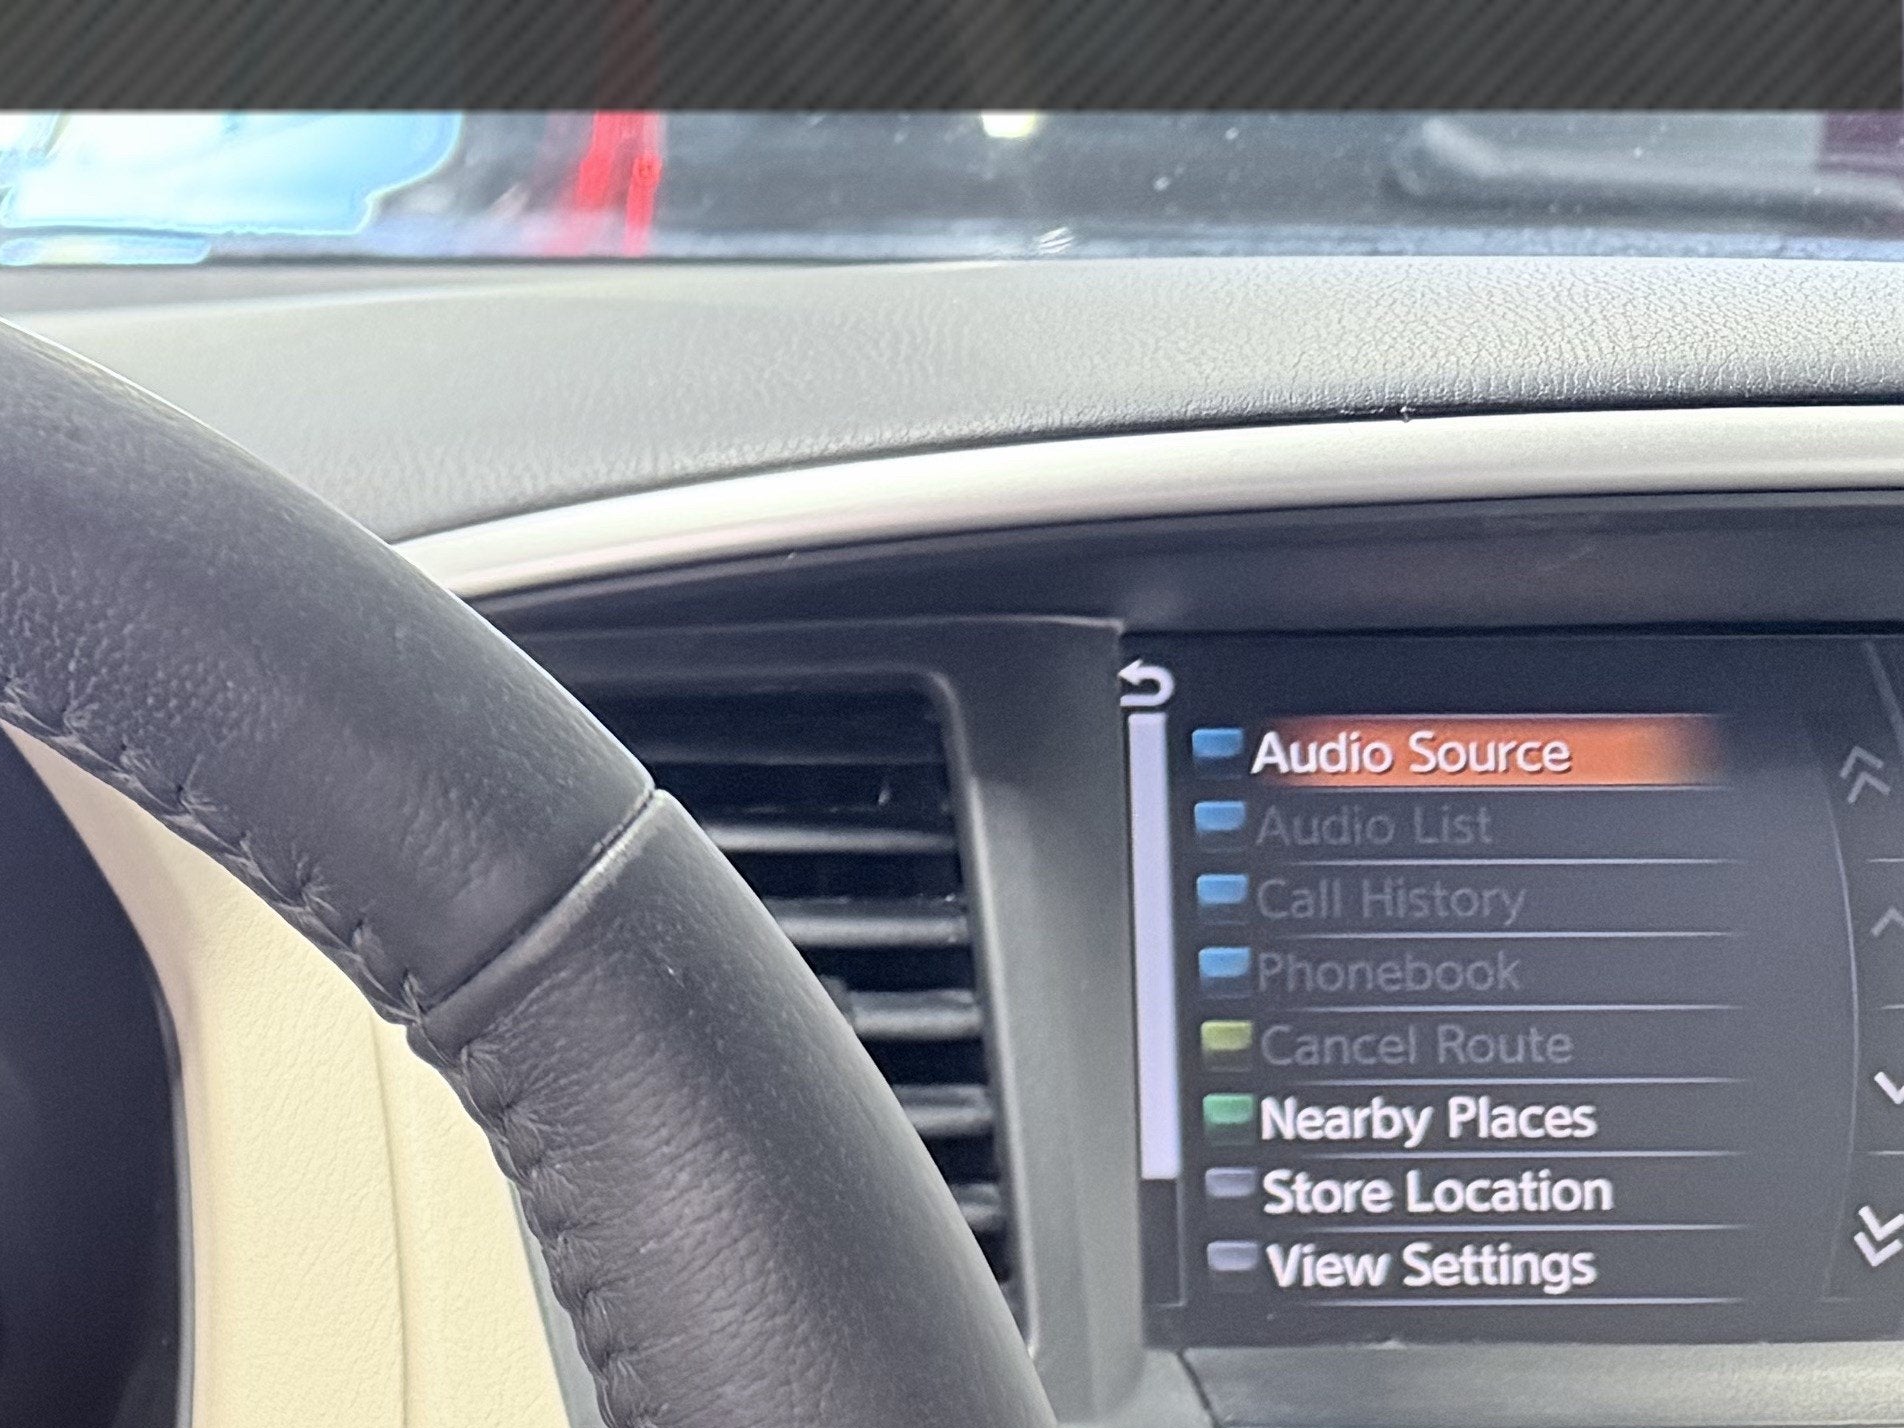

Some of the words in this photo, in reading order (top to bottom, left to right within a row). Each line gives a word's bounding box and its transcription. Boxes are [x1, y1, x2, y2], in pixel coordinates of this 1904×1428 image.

[1250, 731, 1394, 776] Audio
[1407, 730, 1573, 777] Source
[1255, 807, 1395, 846] Audio
[1413, 807, 1494, 846] List
[1256, 879, 1342, 922] Call
[1362, 878, 1528, 926] History
[1257, 952, 1523, 992] Phonebook
[1261, 1025, 1418, 1066] Cancel
[1438, 1025, 1576, 1065] Route
[1260, 1096, 1432, 1149] Nearby
[1447, 1096, 1600, 1141] Places
[1262, 1170, 1394, 1216] Store
[1406, 1169, 1615, 1214] Location
[1266, 1244, 1392, 1289] View
[1402, 1243, 1599, 1295] Settings
